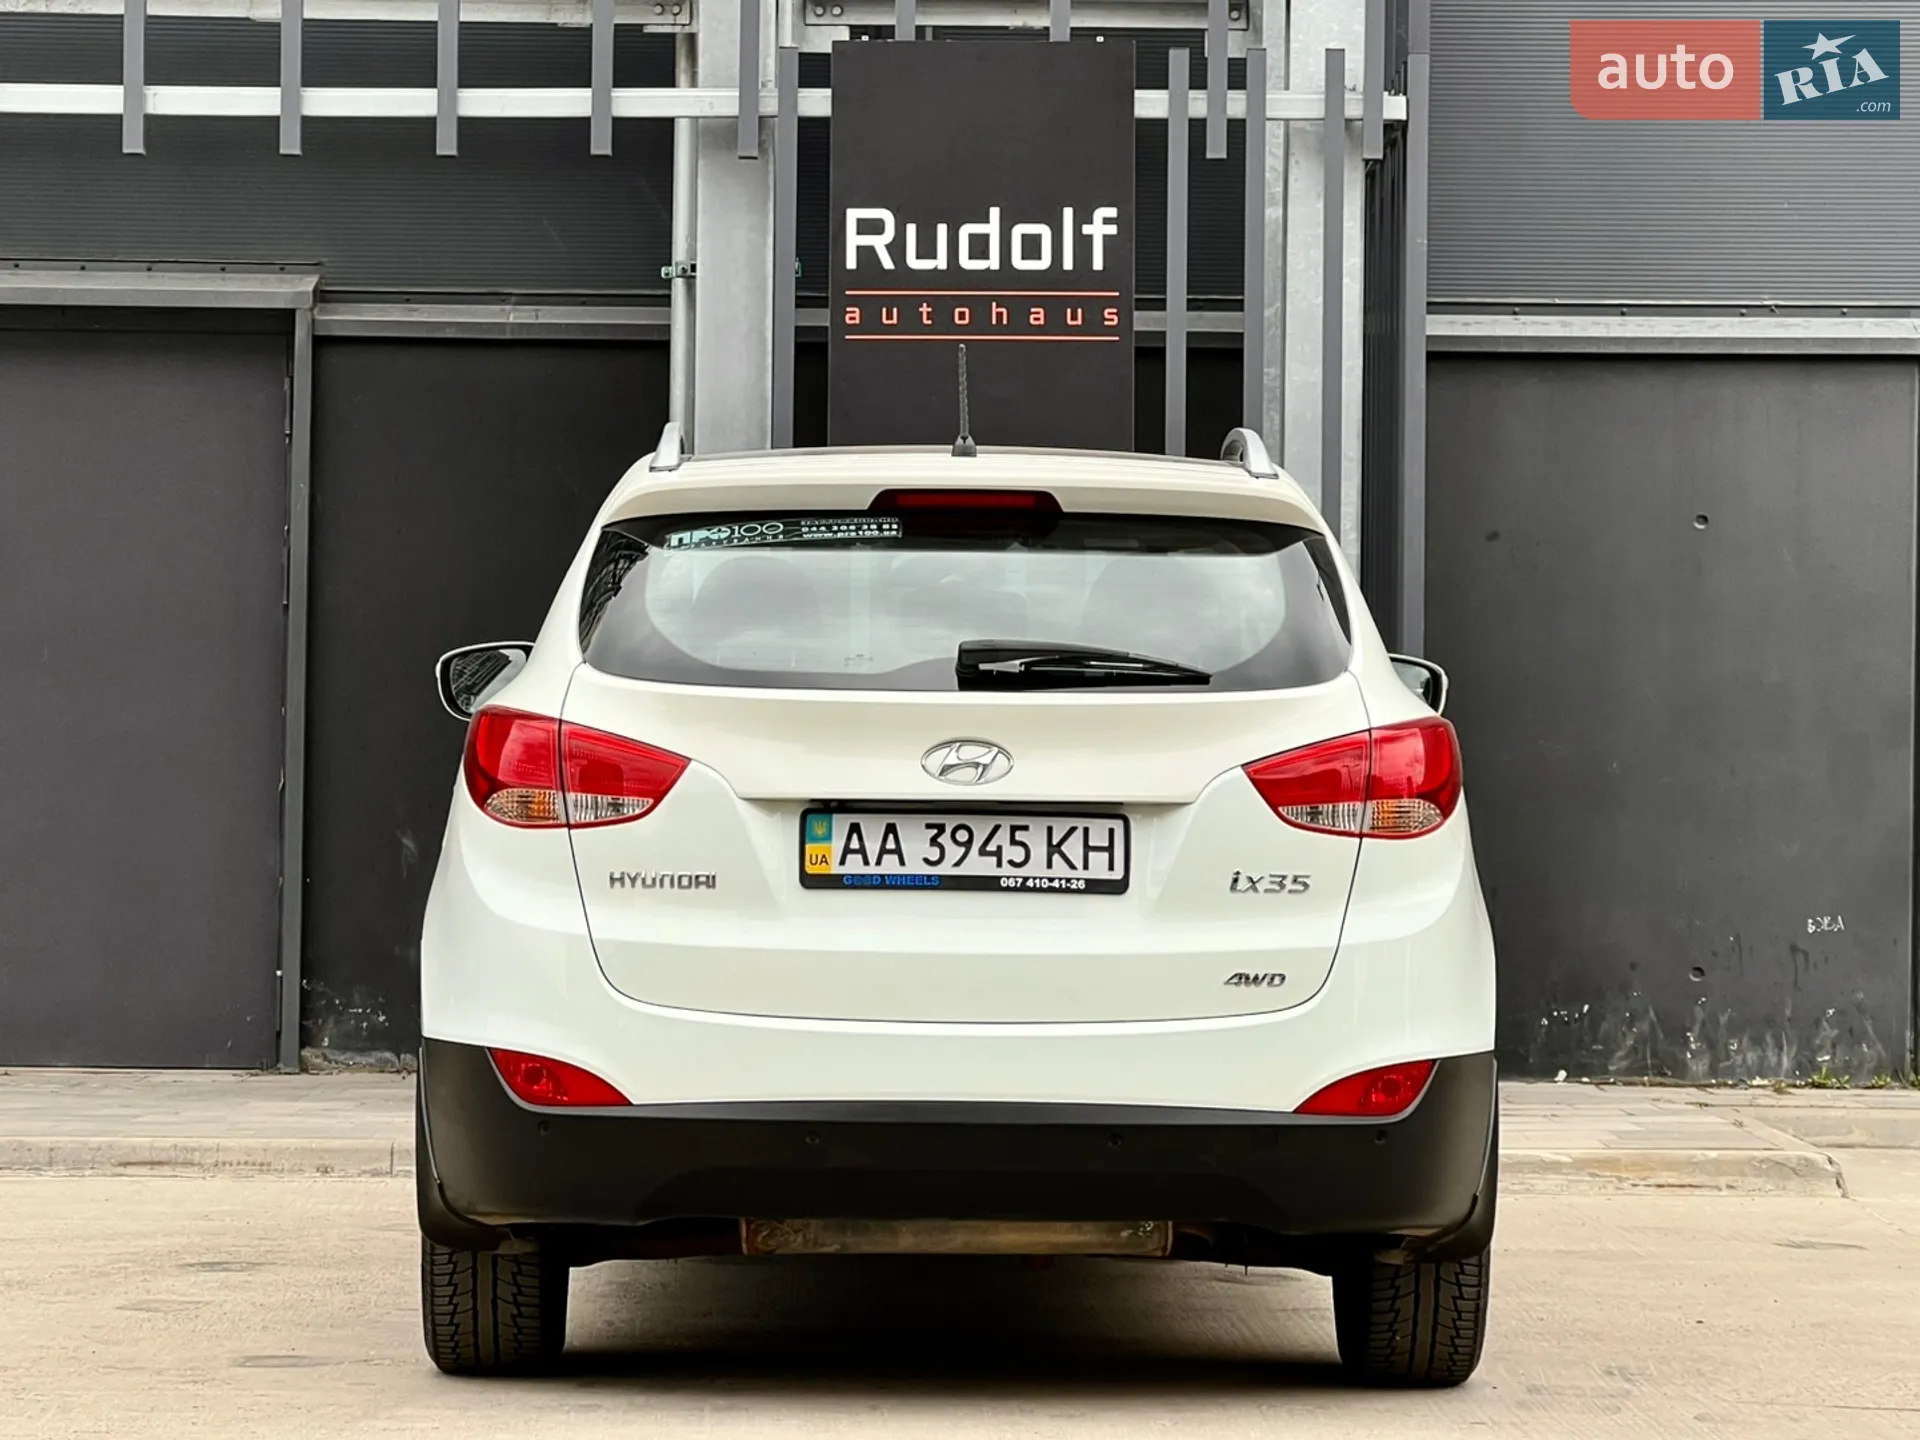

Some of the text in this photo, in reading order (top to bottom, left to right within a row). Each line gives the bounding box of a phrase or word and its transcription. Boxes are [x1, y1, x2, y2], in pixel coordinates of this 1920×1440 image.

[845, 206, 1118, 271] Rudolf
[844, 301, 1119, 325] autohaus
[838, 822, 1116, 872] AA 3945 KH
[809, 853, 829, 866] UA
[608, 871, 717, 889] HYUNDAI
[884, 875, 941, 886] WHEELS
[1000, 877, 1086, 890] 067 410-41-26
[1229, 869, 1311, 894] ix35
[1223, 971, 1287, 987] 4WD
